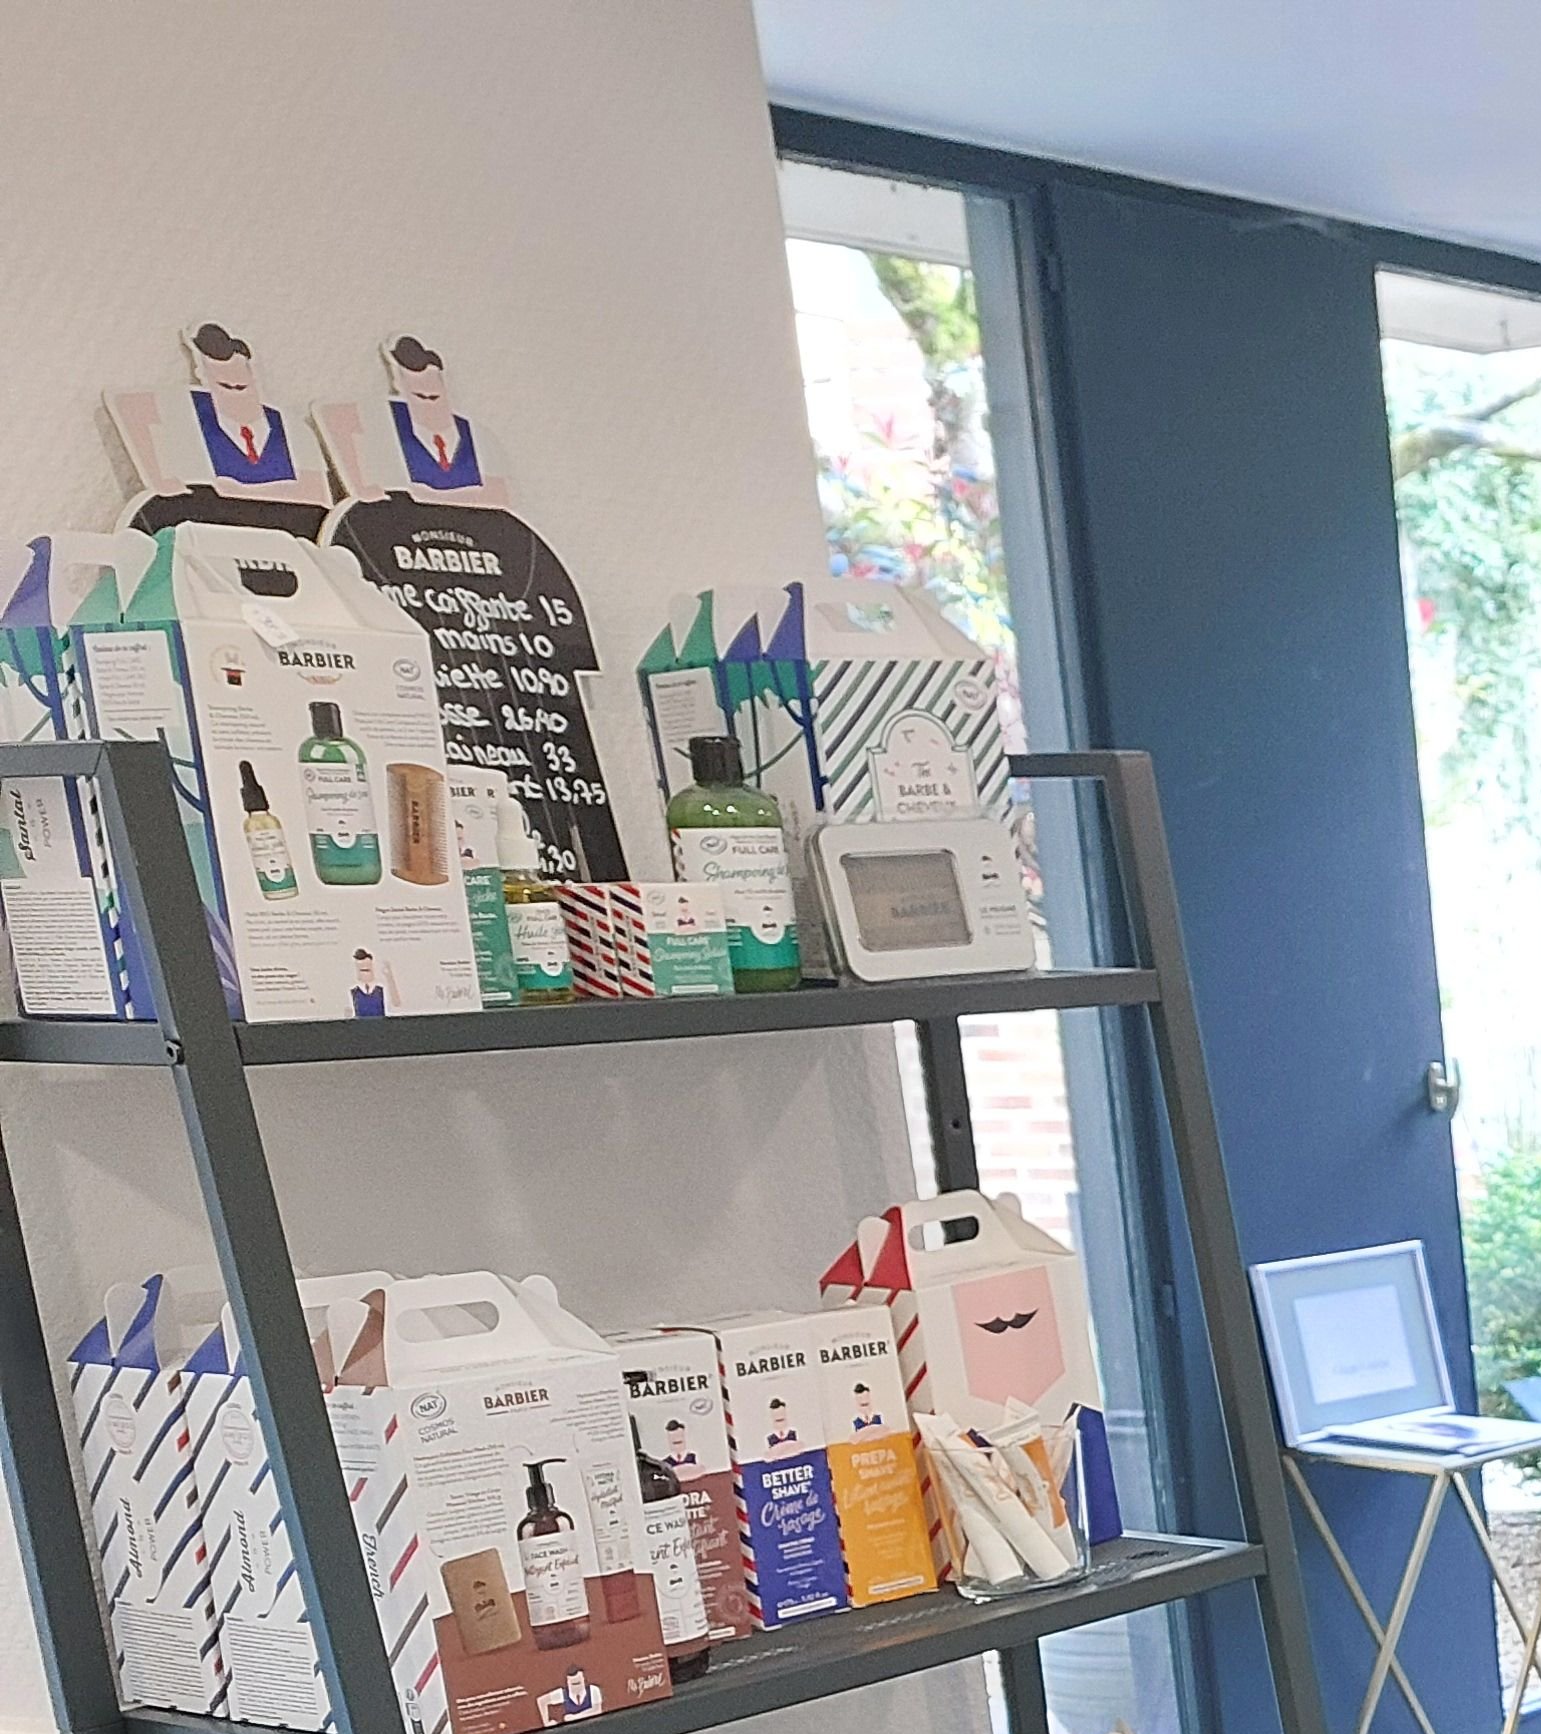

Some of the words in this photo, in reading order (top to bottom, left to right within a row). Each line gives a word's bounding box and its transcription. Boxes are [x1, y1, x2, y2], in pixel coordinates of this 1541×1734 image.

[394, 546, 502, 575] BARBIER
[539, 595, 573, 626] 15
[434, 627, 517, 656] mains
[278, 651, 357, 670] BARBIER
[543, 742, 577, 773] 33
[735, 1352, 806, 1377] BARBIER
[819, 1341, 888, 1363] BARBIER
[483, 1388, 550, 1410] BARBIER
[629, 1375, 710, 1399] BARBIER
[762, 1464, 814, 1489] BETTER
[119, 1497, 142, 1578] Almond
[233, 1510, 255, 1592] Almond
